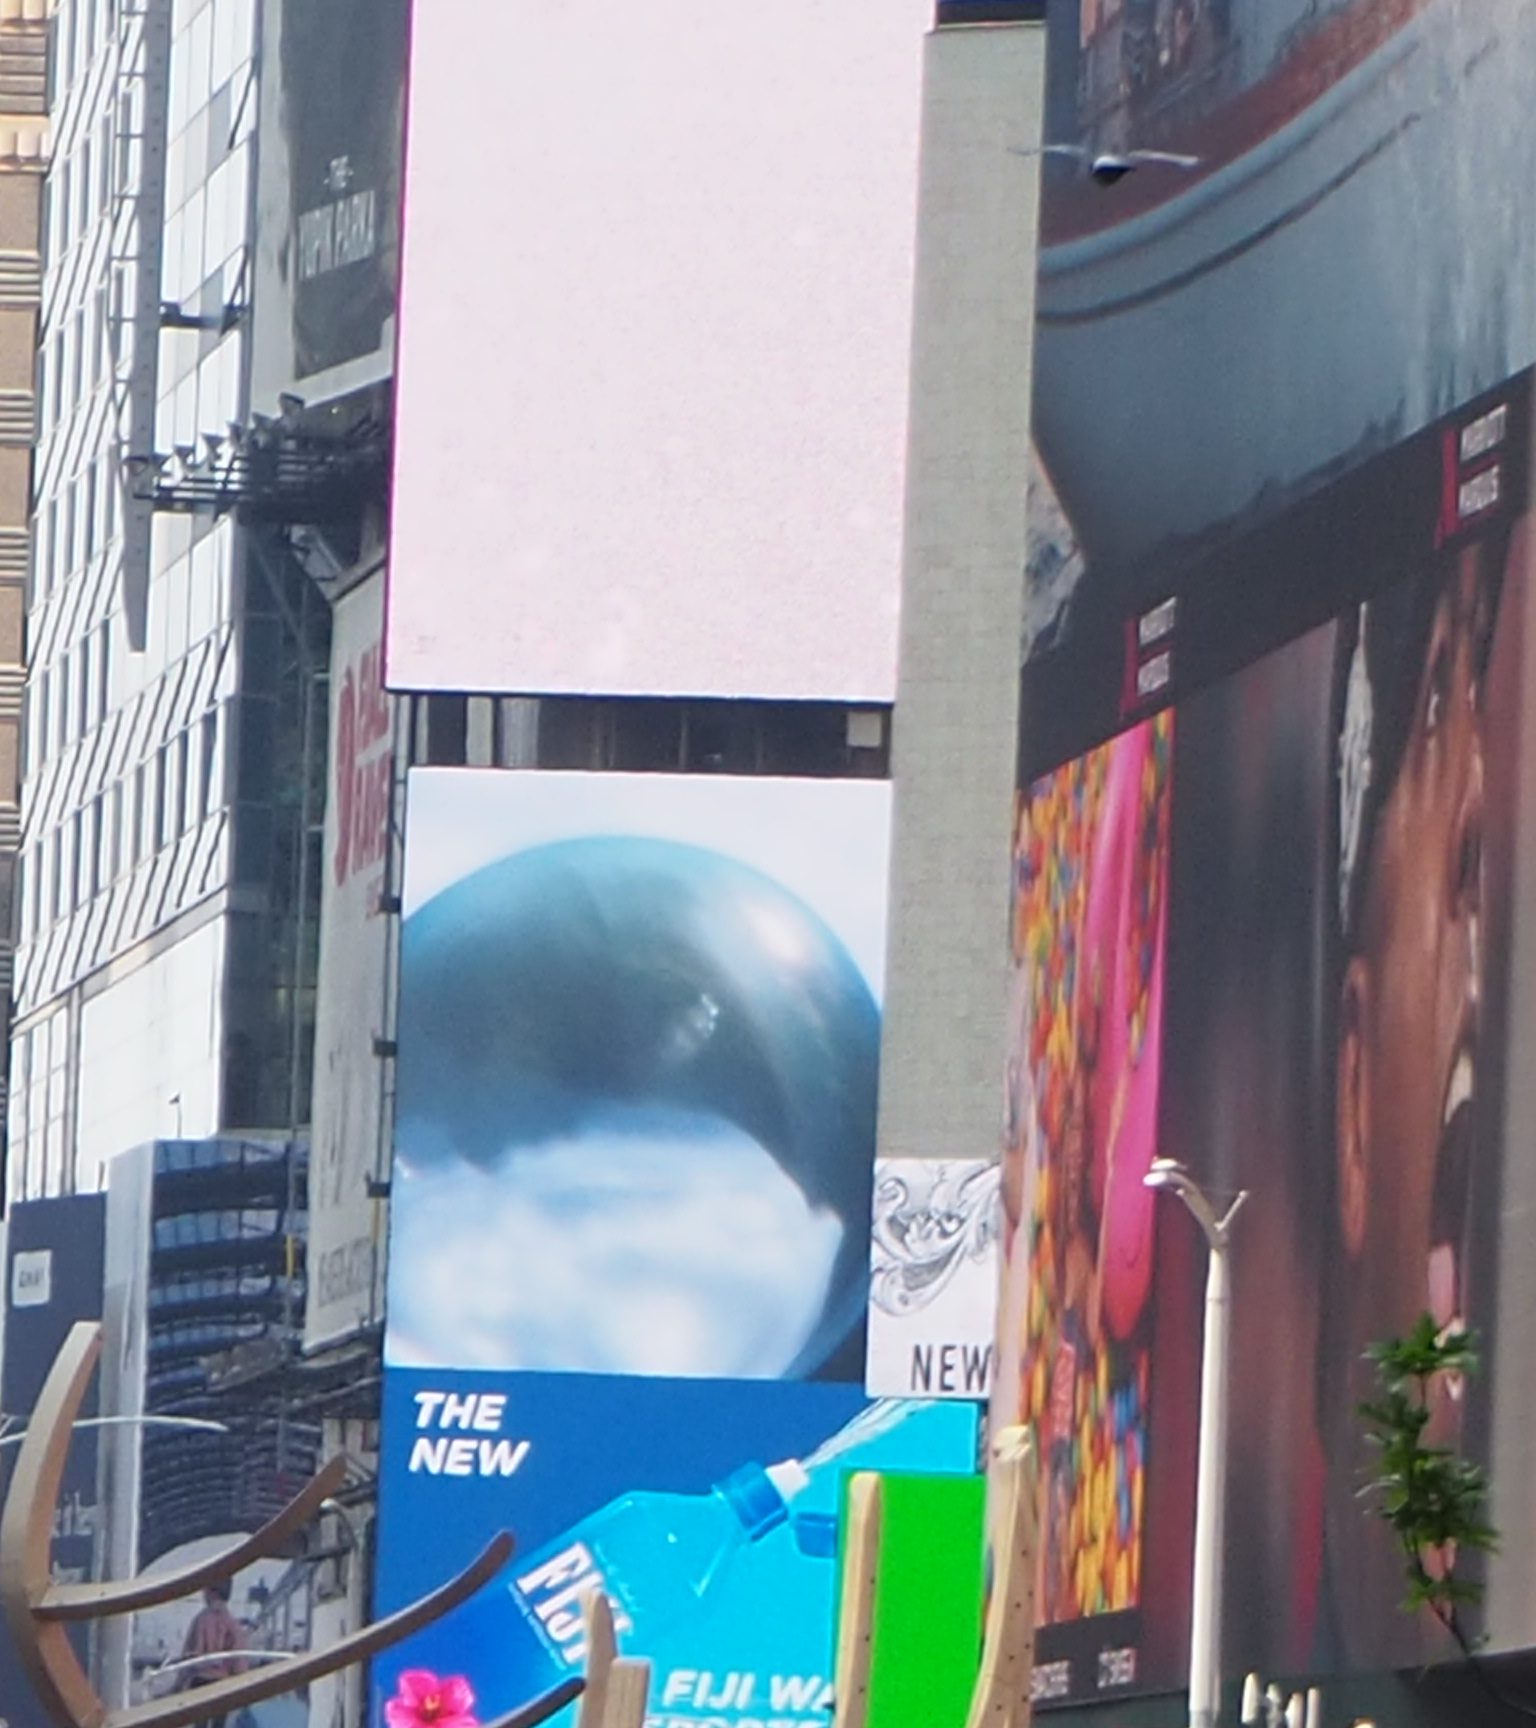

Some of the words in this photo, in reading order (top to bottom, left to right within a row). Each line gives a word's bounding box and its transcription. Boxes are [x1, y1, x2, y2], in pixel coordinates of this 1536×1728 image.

[413, 1391, 507, 1431] THE
[409, 1437, 529, 1478] NEW
[662, 1671, 751, 1712] FIJI
